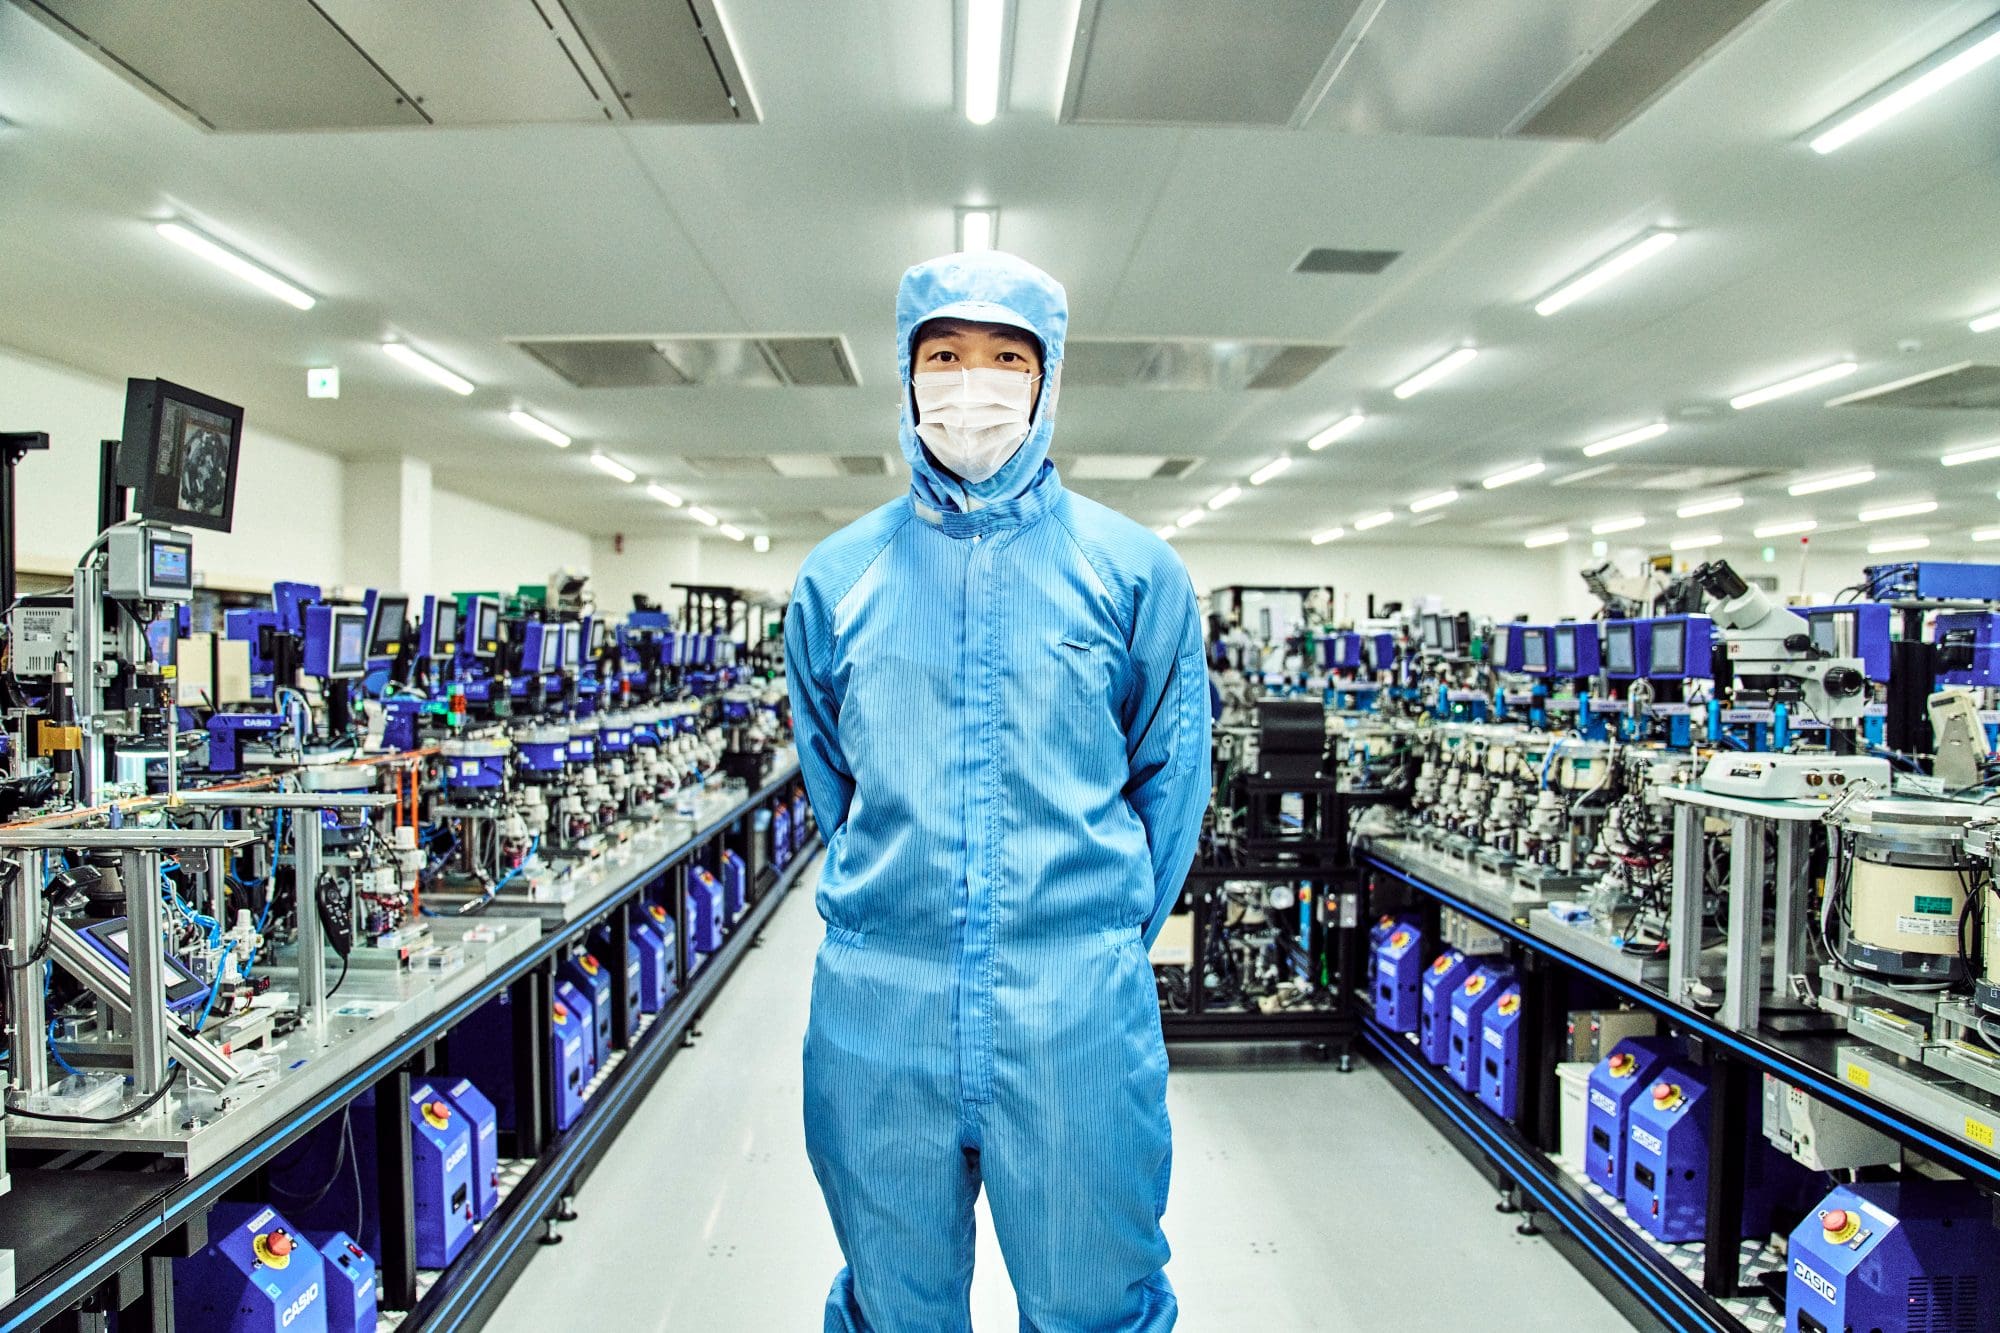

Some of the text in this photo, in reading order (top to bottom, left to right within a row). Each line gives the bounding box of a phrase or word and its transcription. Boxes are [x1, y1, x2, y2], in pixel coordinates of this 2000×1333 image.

[243, 719, 271, 727] CASIO
[1794, 1262, 1836, 1301] CASIO
[282, 1283, 318, 1327] CASIO
